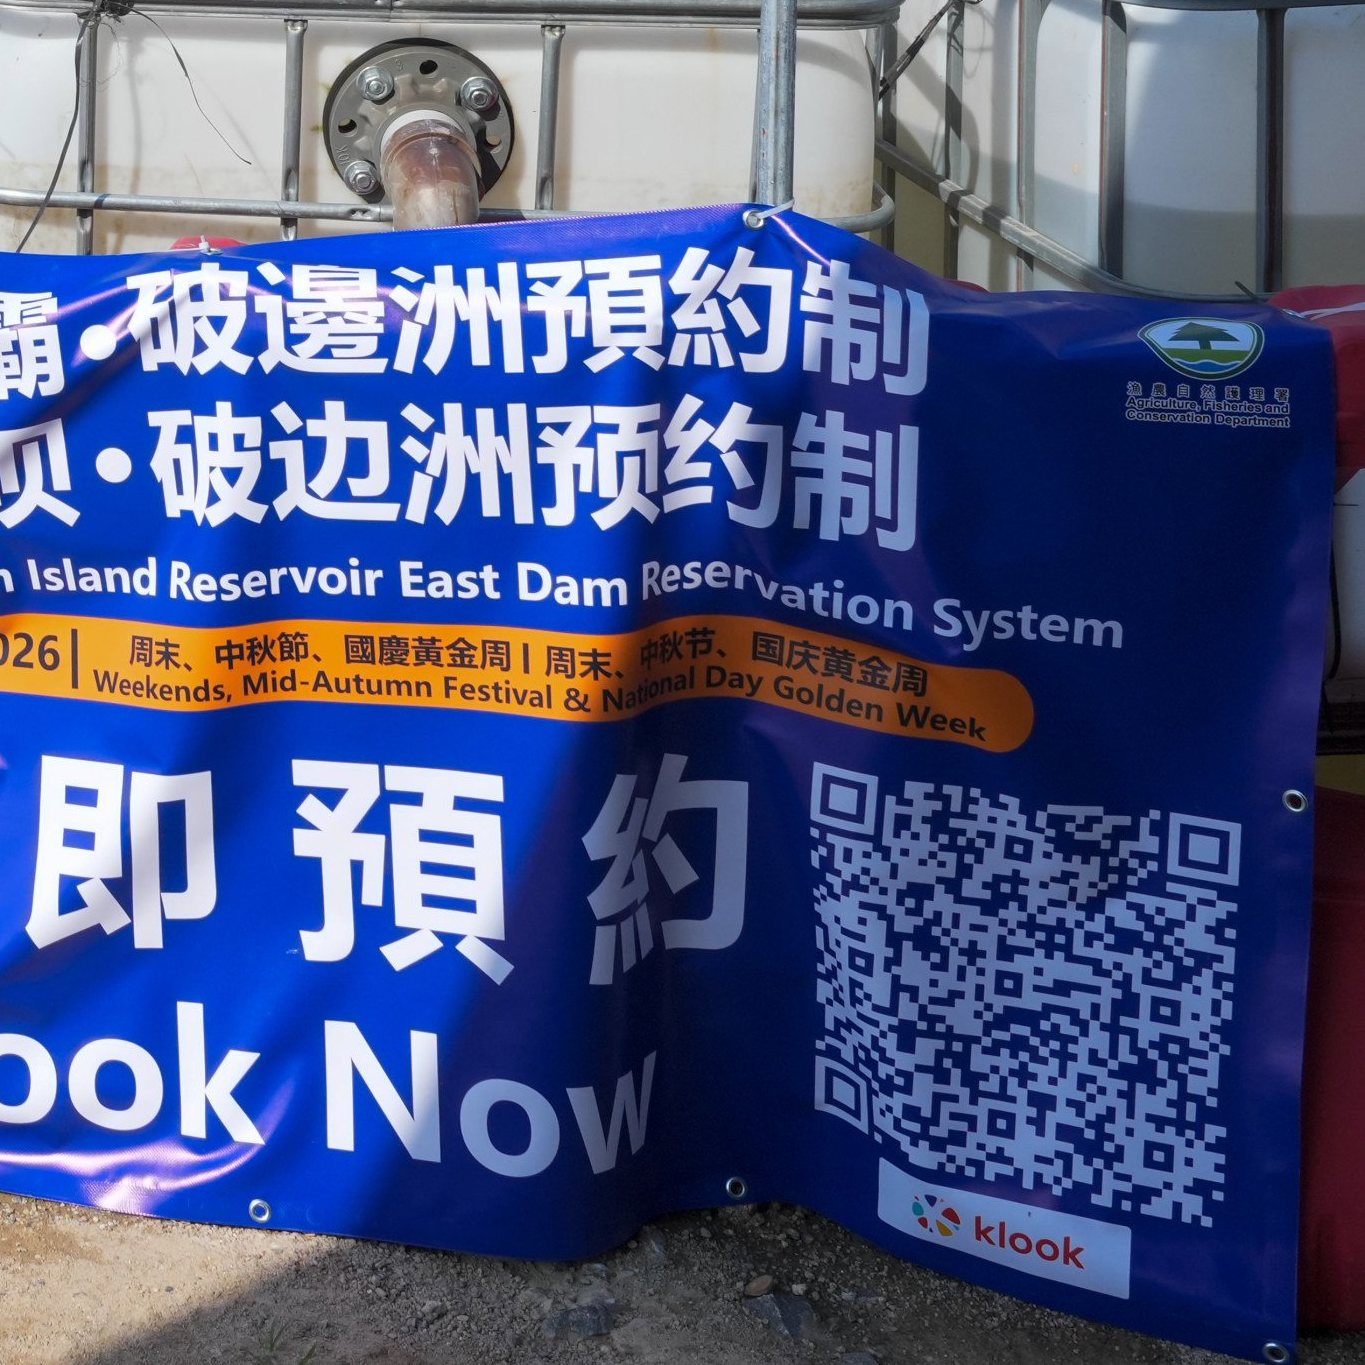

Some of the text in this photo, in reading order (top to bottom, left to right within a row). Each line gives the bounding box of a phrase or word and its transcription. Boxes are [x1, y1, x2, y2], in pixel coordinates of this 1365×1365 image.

[1125, 409, 1290, 428] Conservation Department
[1126, 396, 1290, 415] Agriculture, Fisheries and
[1127, 381, 1290, 402] 漁農自然護理署
[27, 557, 157, 597] Island
[170, 558, 384, 602] Reservoir
[400, 560, 500, 600] East
[517, 561, 628, 607] Dam
[642, 560, 914, 631] Reservation
[933, 598, 1124, 651] System
[93, 664, 987, 742] Weekends, Mid-Autumn Festival & National Day Golden Week
[324, 1019, 657, 1176] Now
[975, 1216, 1085, 1270] klook
